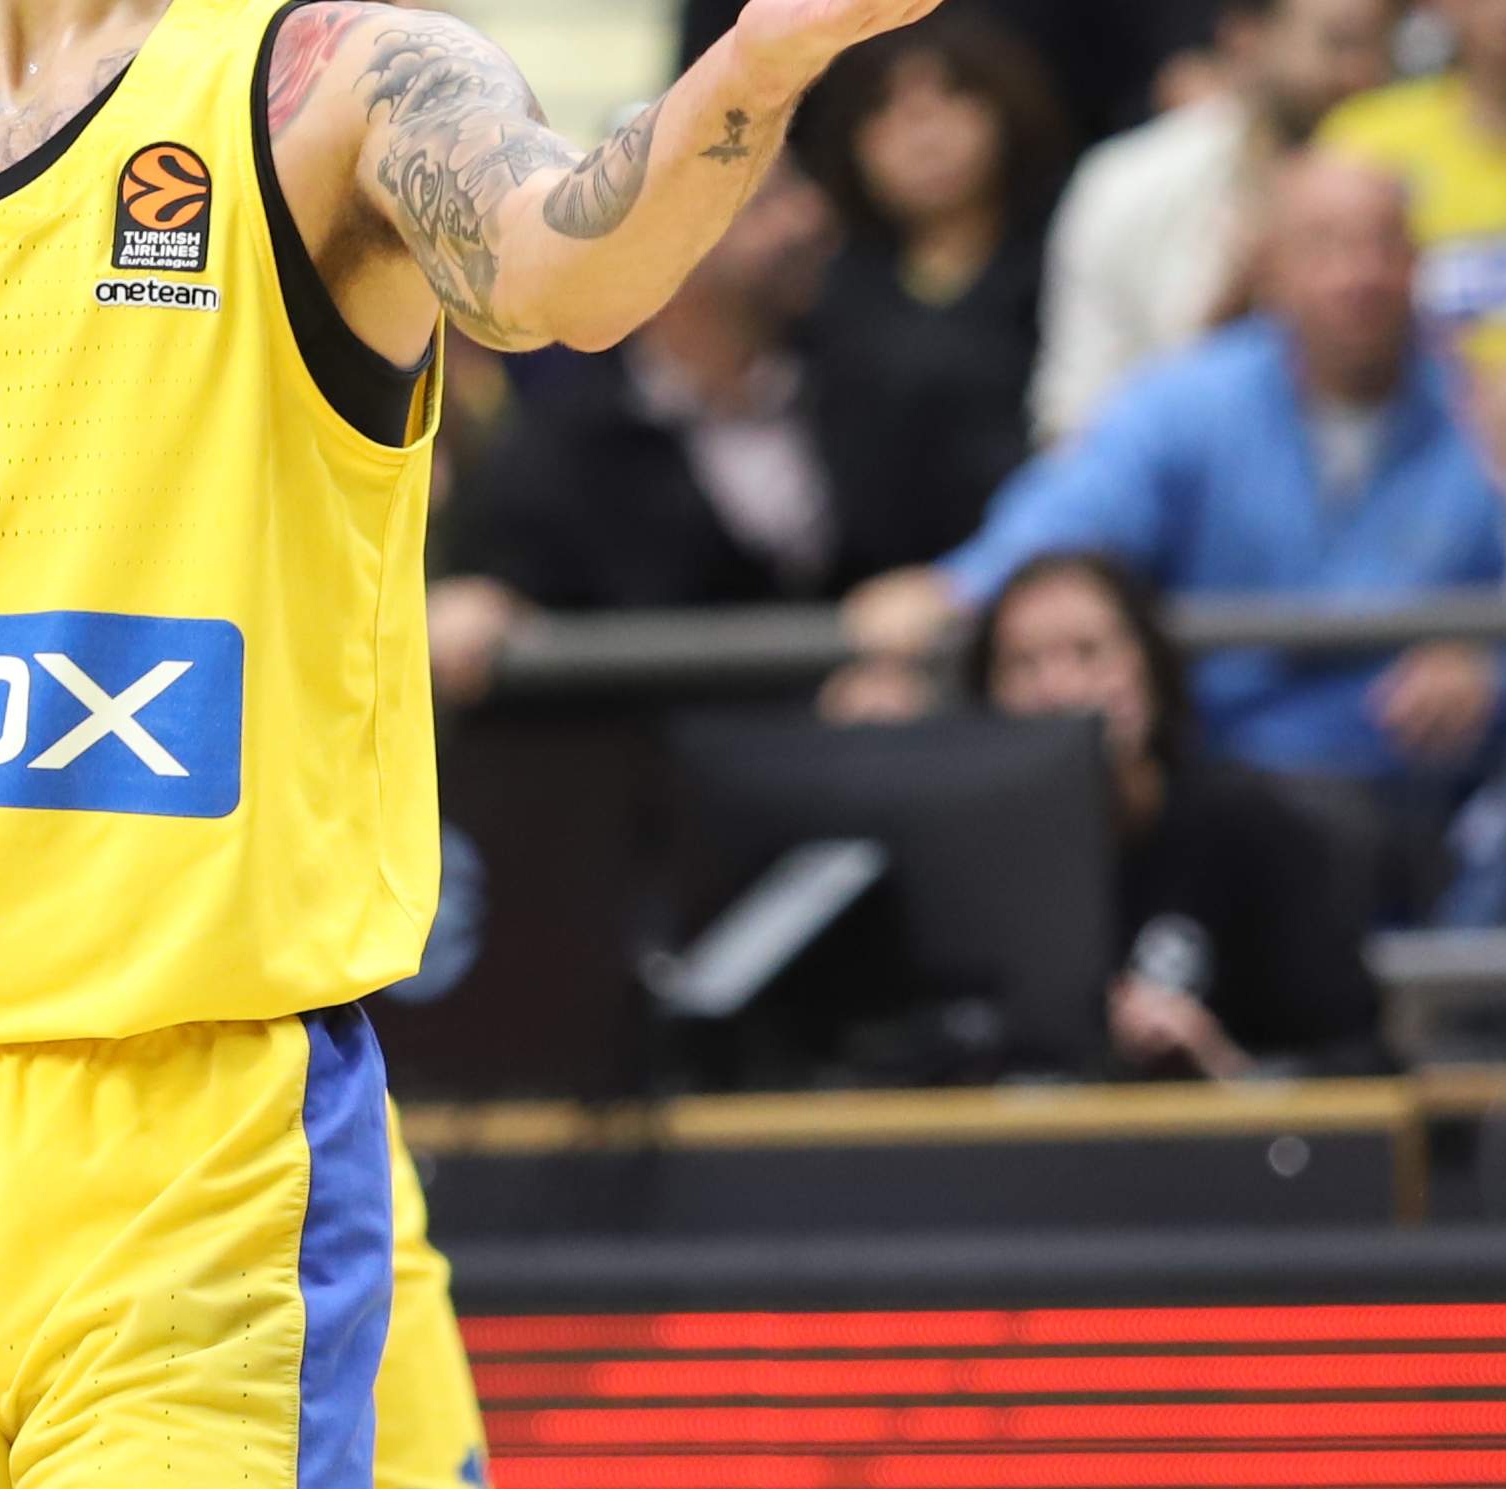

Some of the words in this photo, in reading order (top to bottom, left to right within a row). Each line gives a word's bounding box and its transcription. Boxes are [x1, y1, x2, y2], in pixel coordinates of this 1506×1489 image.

[122, 230, 202, 246] TURKISH
[120, 243, 200, 258] AIRLINES
[118, 255, 199, 268] EuroLeague
